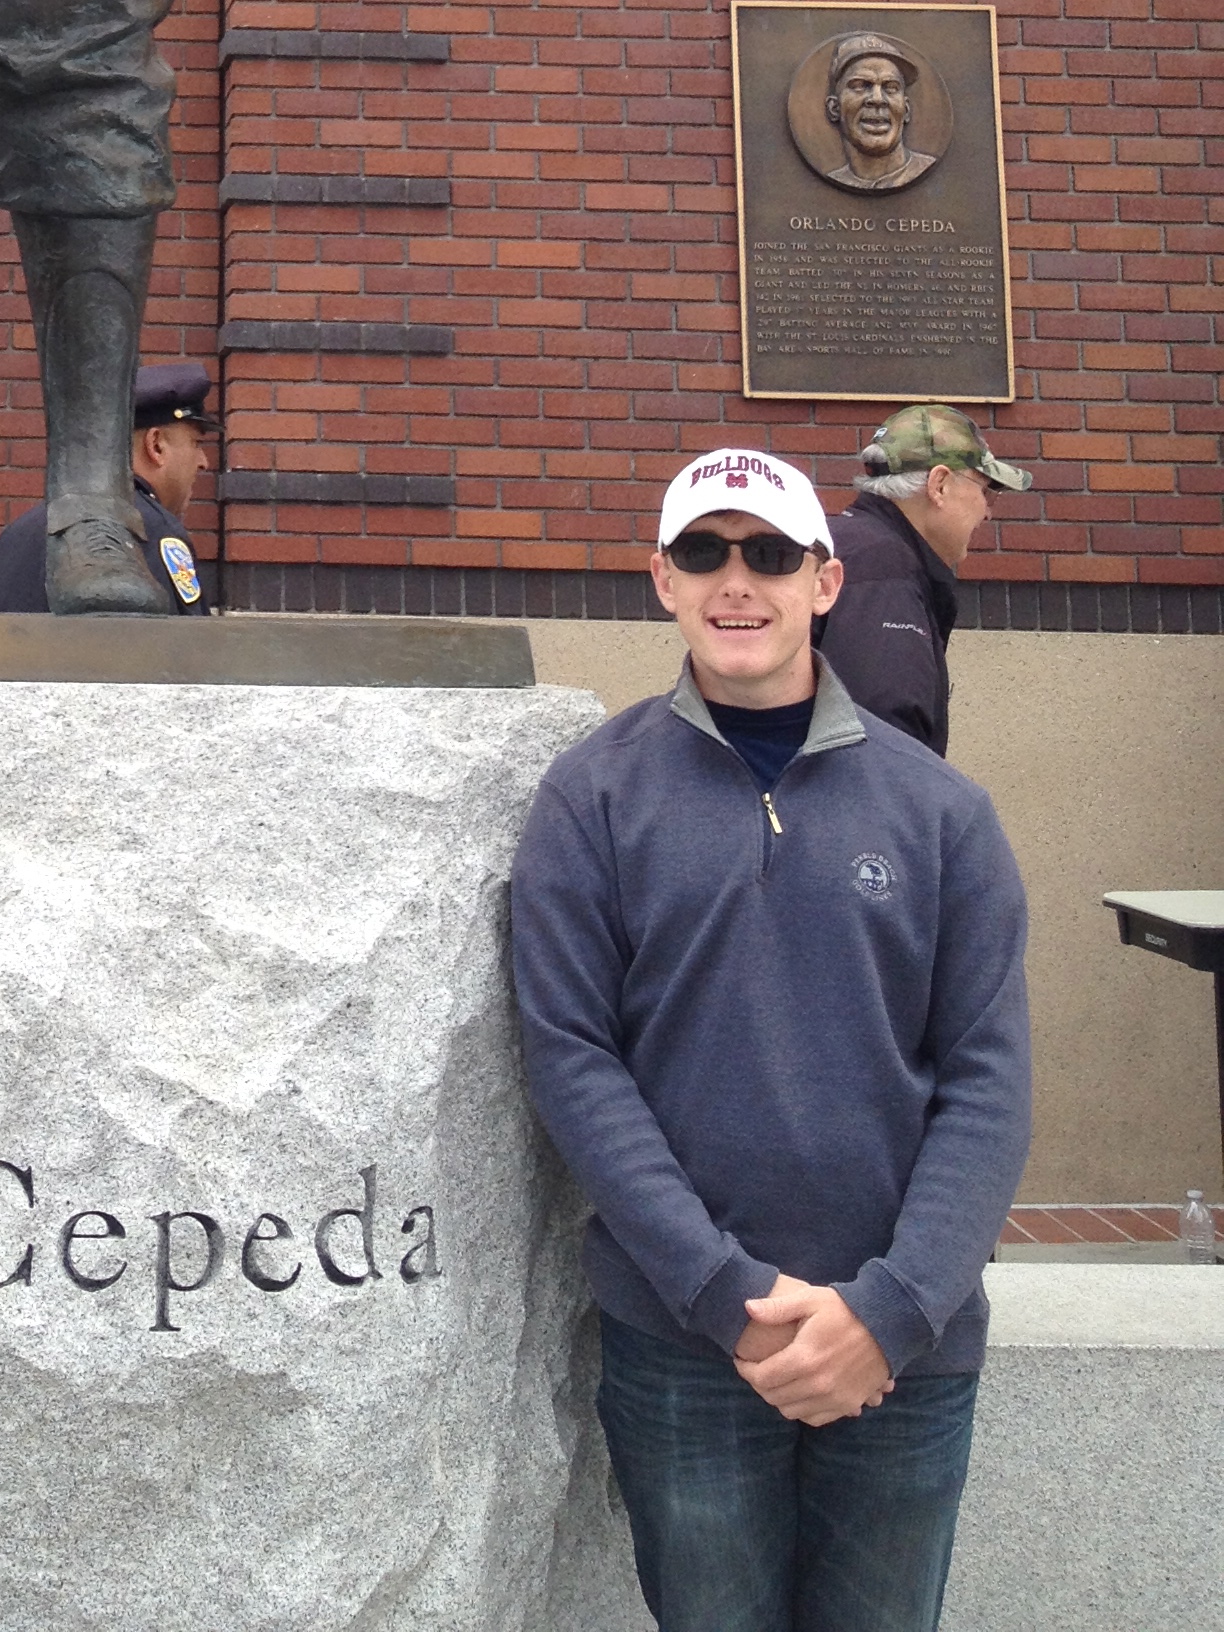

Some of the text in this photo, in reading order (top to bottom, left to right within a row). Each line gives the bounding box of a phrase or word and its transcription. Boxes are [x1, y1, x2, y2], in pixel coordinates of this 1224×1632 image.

[789, 216, 955, 234] ORLANDO CEPEDA
[753, 241, 786, 249] JOINED
[790, 242, 808, 250] THE
[835, 242, 889, 251] FRANCISCO
[893, 243, 928, 252] GIANTS
[932, 244, 943, 252] AS
[958, 244, 993, 253] ROOKIE
[753, 254, 763, 262] IN
[794, 255, 812, 263] AND
[819, 255, 838, 263] WAS
[843, 255, 890, 264] SELECTED
[914, 257, 932, 265] THE
[788, 267, 823, 276] BATTED
[868, 268, 884, 277] HIS
[925, 269, 965, 278] SEASONS
[970, 270, 982, 278] AS
[753, 279, 783, 288] GIANT
[787, 280, 807, 288] AND
[811, 280, 830, 289] LED
[834, 281, 852, 289] THE
[872, 281, 883, 289] IN
[946, 283, 967, 291] AND
[772, 293, 782, 301] IN
[809, 293, 856, 302] SELECTED
[859, 294, 872, 302] TO
[876, 294, 894, 303] THE
[754, 305, 791, 314] PLAYED
[857, 307, 875, 315] THE
[914, 307, 957, 316] LEAGUES
[960, 308, 985, 317] WITH
[824, 319, 866, 328] AVERAGE
[873, 320, 892, 328] AND
[926, 321, 956, 329] AWARD
[962, 321, 972, 330] IN
[784, 331, 801, 340] THE
[979, 334, 998, 343] THE
[689, 455, 786, 491] BULLDOGS
